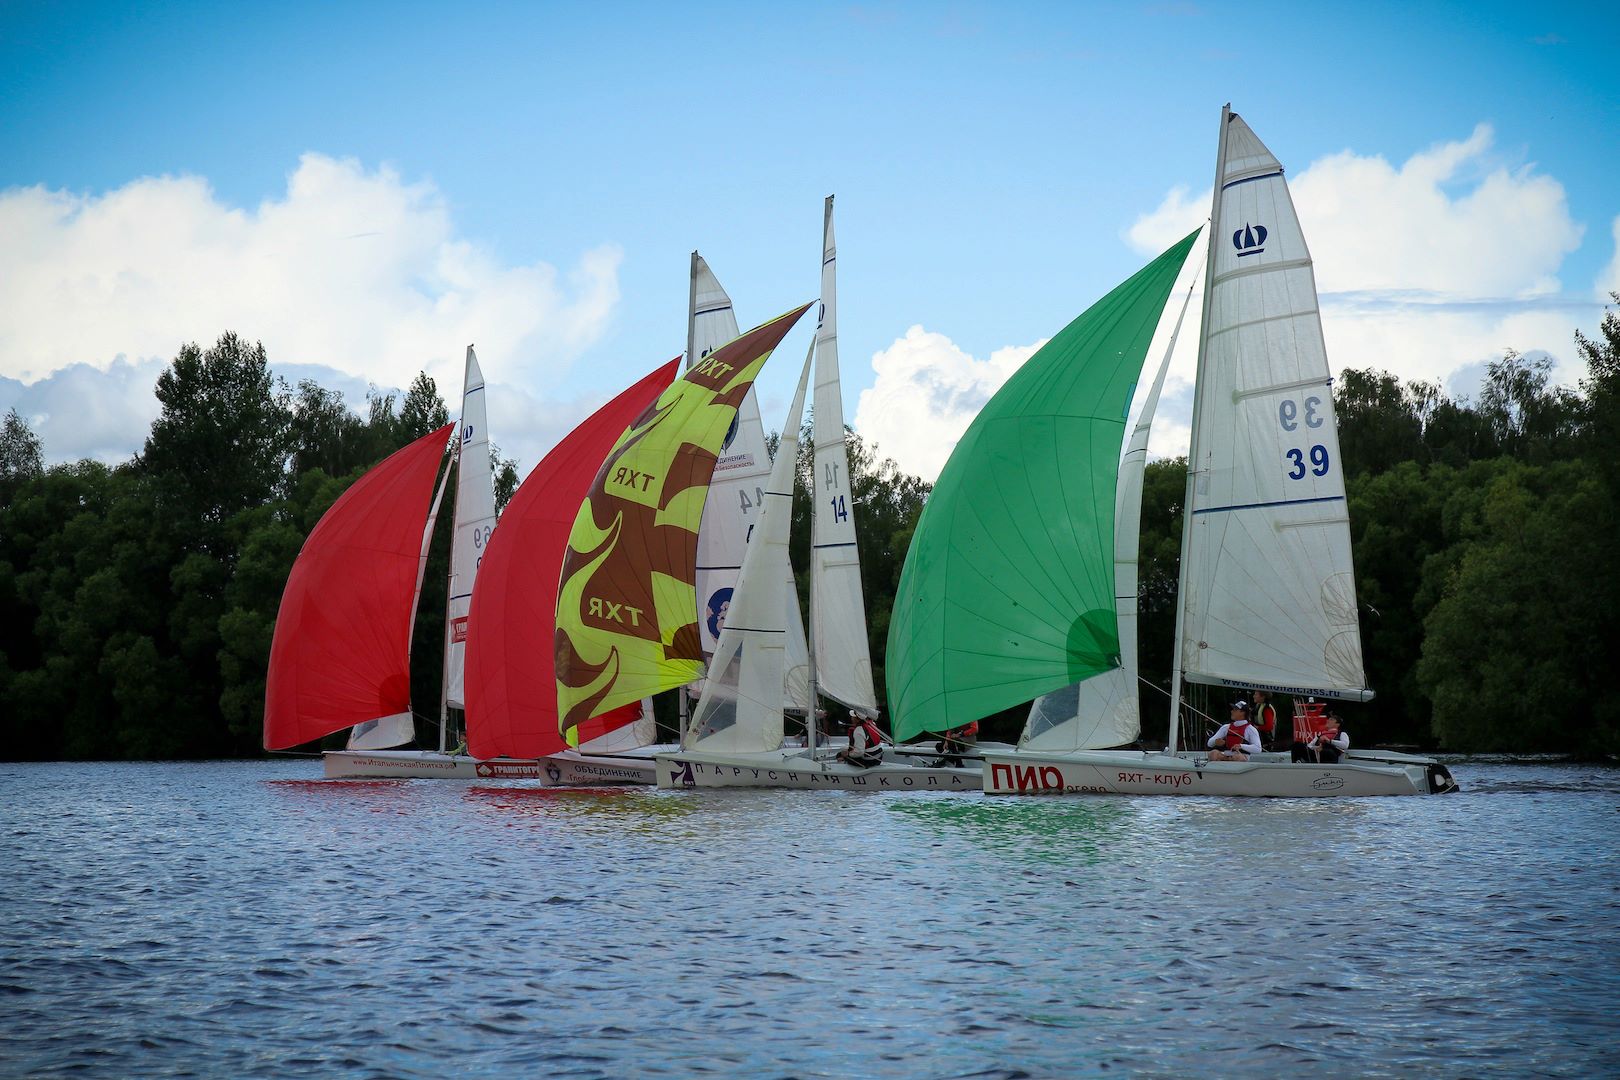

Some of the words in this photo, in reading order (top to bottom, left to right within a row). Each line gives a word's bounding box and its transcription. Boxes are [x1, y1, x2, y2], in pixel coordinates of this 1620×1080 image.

[1286, 444, 1330, 480] 39
[613, 466, 655, 492] ЯХТ
[830, 494, 848, 524] 14
[588, 597, 643, 627] ЯХТ
[574, 764, 644, 779] ОБЪЕДИНЕНИЕ
[693, 762, 841, 784] ПАРУСНАЯ
[852, 775, 962, 786] ШКОЛА
